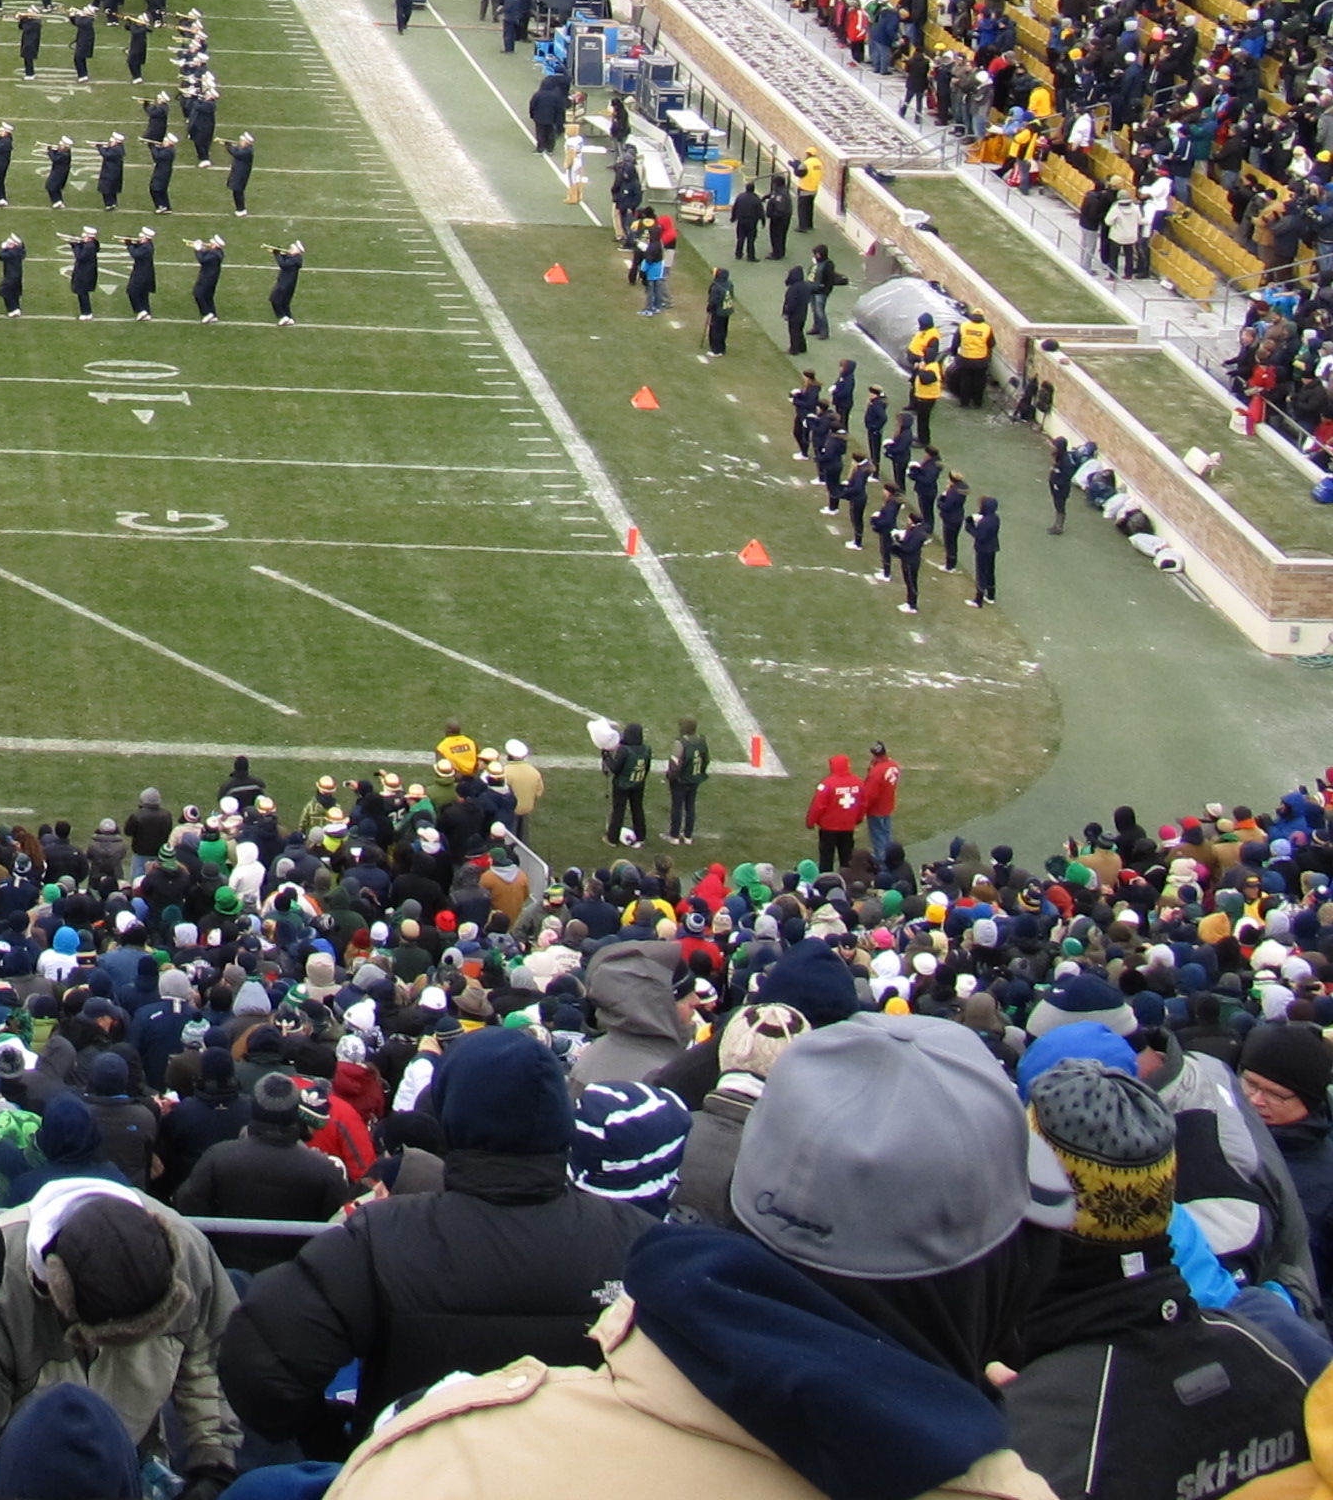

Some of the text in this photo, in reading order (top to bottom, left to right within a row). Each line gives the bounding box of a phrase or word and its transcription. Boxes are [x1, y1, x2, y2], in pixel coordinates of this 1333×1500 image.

[84, 359, 191, 406] 10
[115, 510, 229, 534] G
[1176, 1430, 1295, 1500] ski-doo
